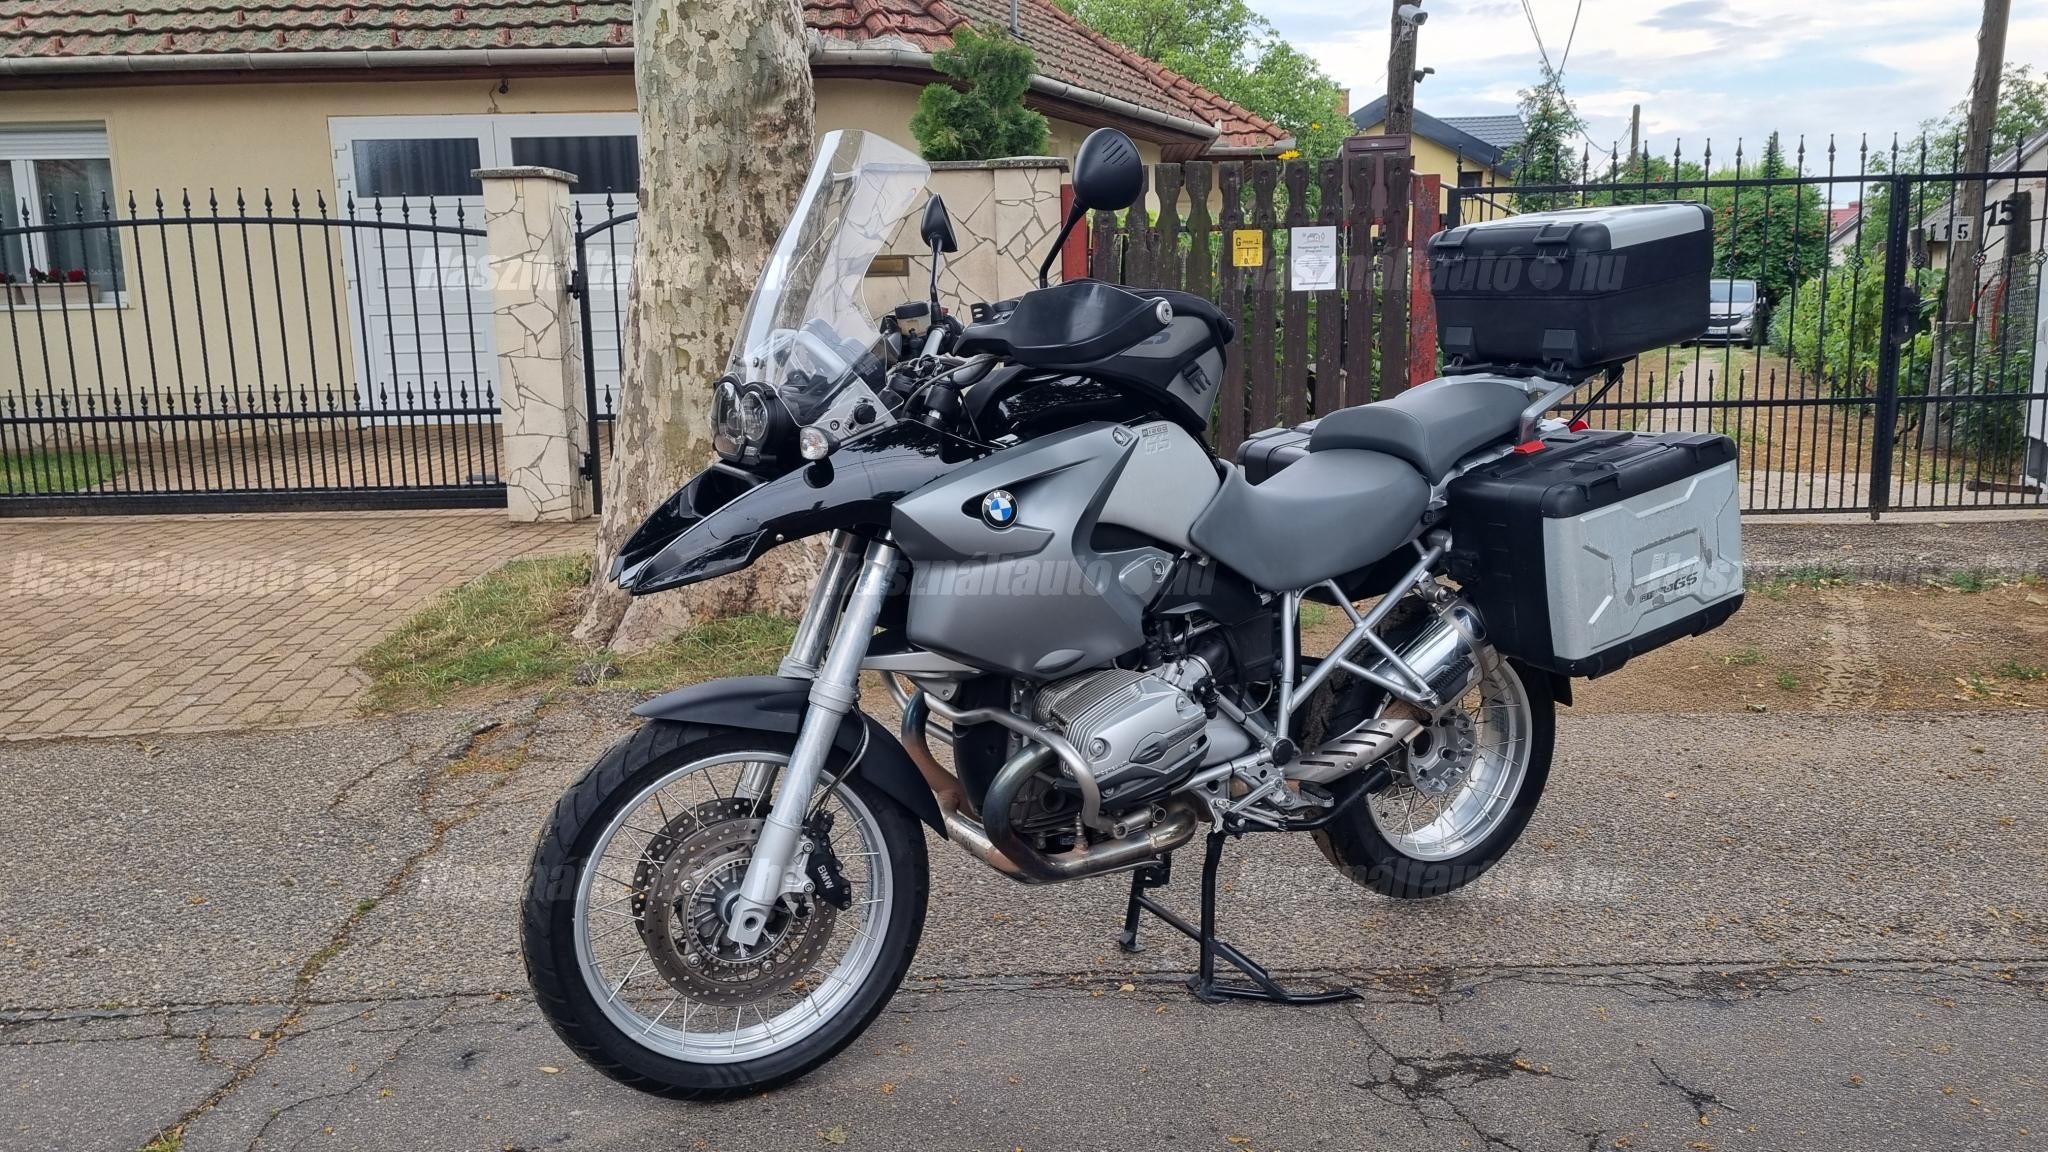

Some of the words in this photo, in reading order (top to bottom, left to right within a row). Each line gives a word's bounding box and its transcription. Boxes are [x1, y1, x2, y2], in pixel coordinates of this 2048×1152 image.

[1983, 200, 2018, 226] 15
[1943, 223, 1969, 240] 15
[984, 491, 1013, 506] BMW
[817, 864, 835, 889] BMW
